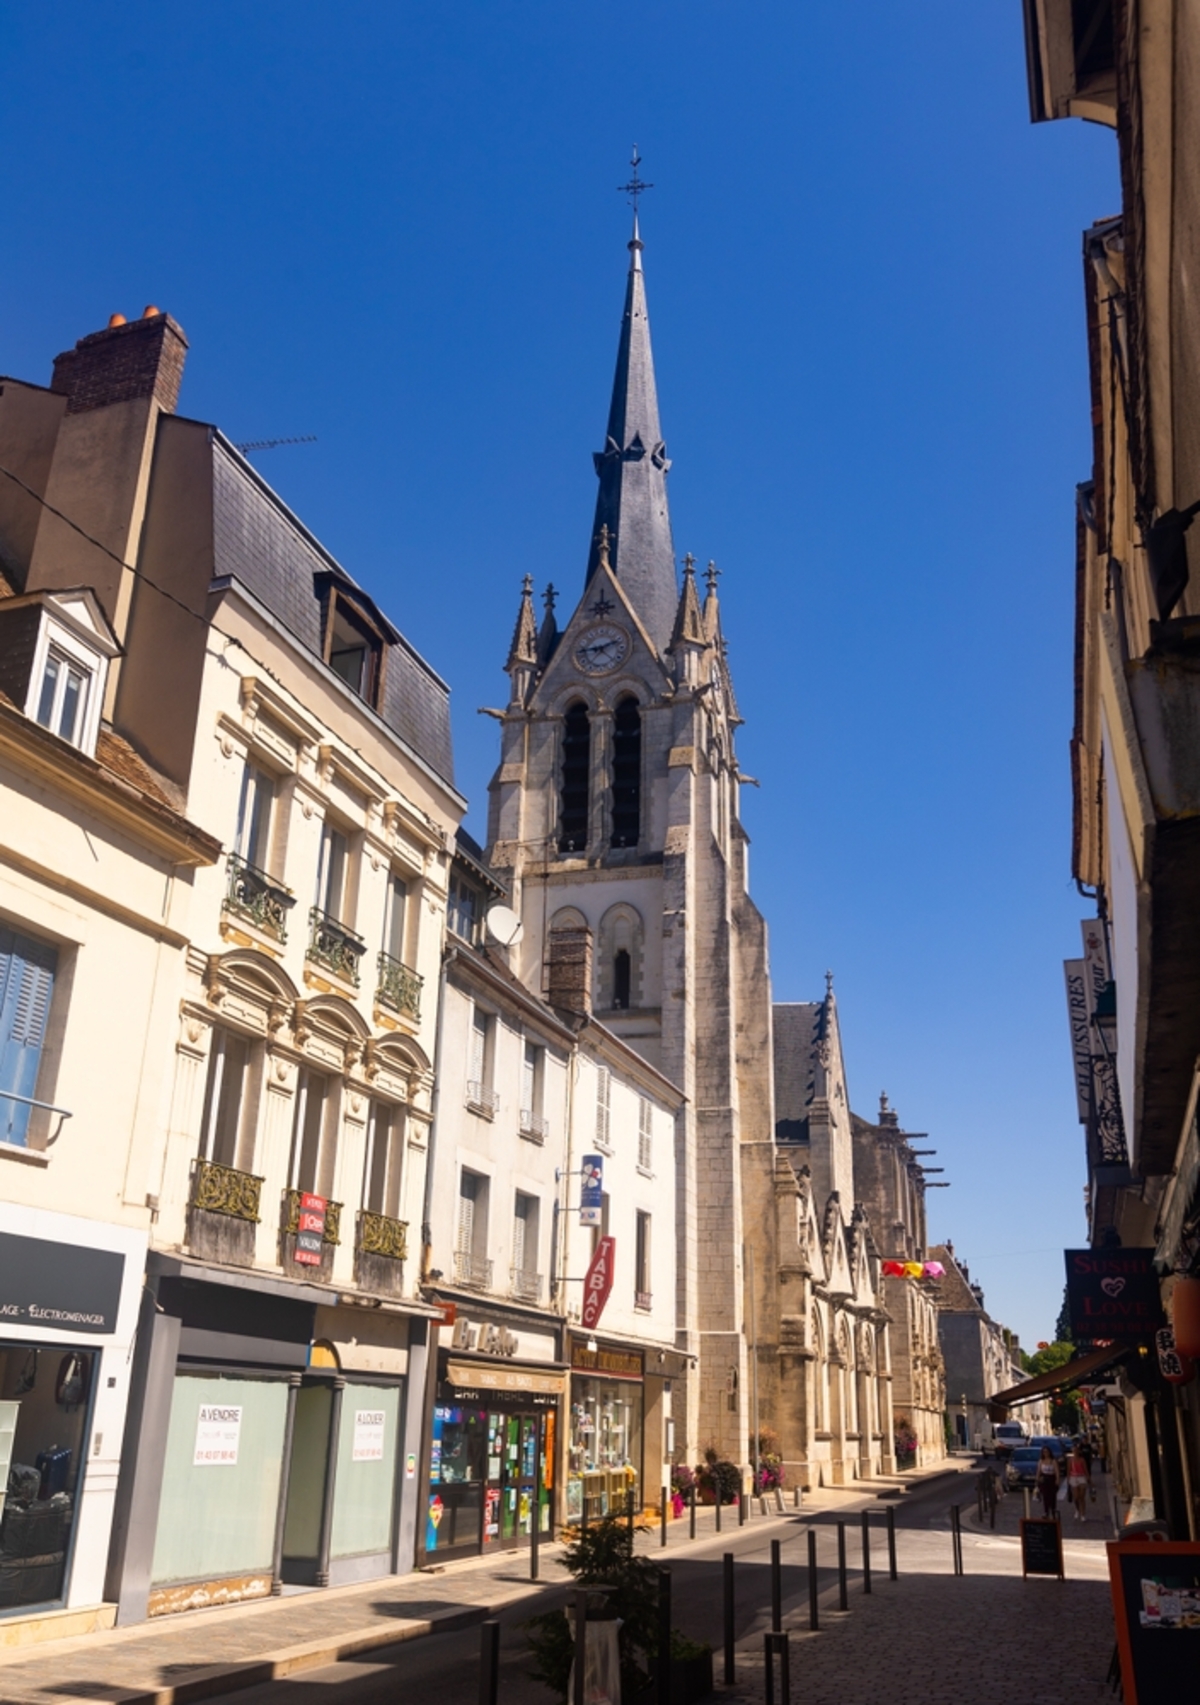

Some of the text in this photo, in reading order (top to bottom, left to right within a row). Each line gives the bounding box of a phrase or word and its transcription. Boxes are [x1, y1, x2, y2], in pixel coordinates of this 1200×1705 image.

[1068, 974, 1091, 1103] CHAUSSURES
[584, 1241, 611, 1322] TABAC
[207, 1408, 239, 1421] VENDRE
